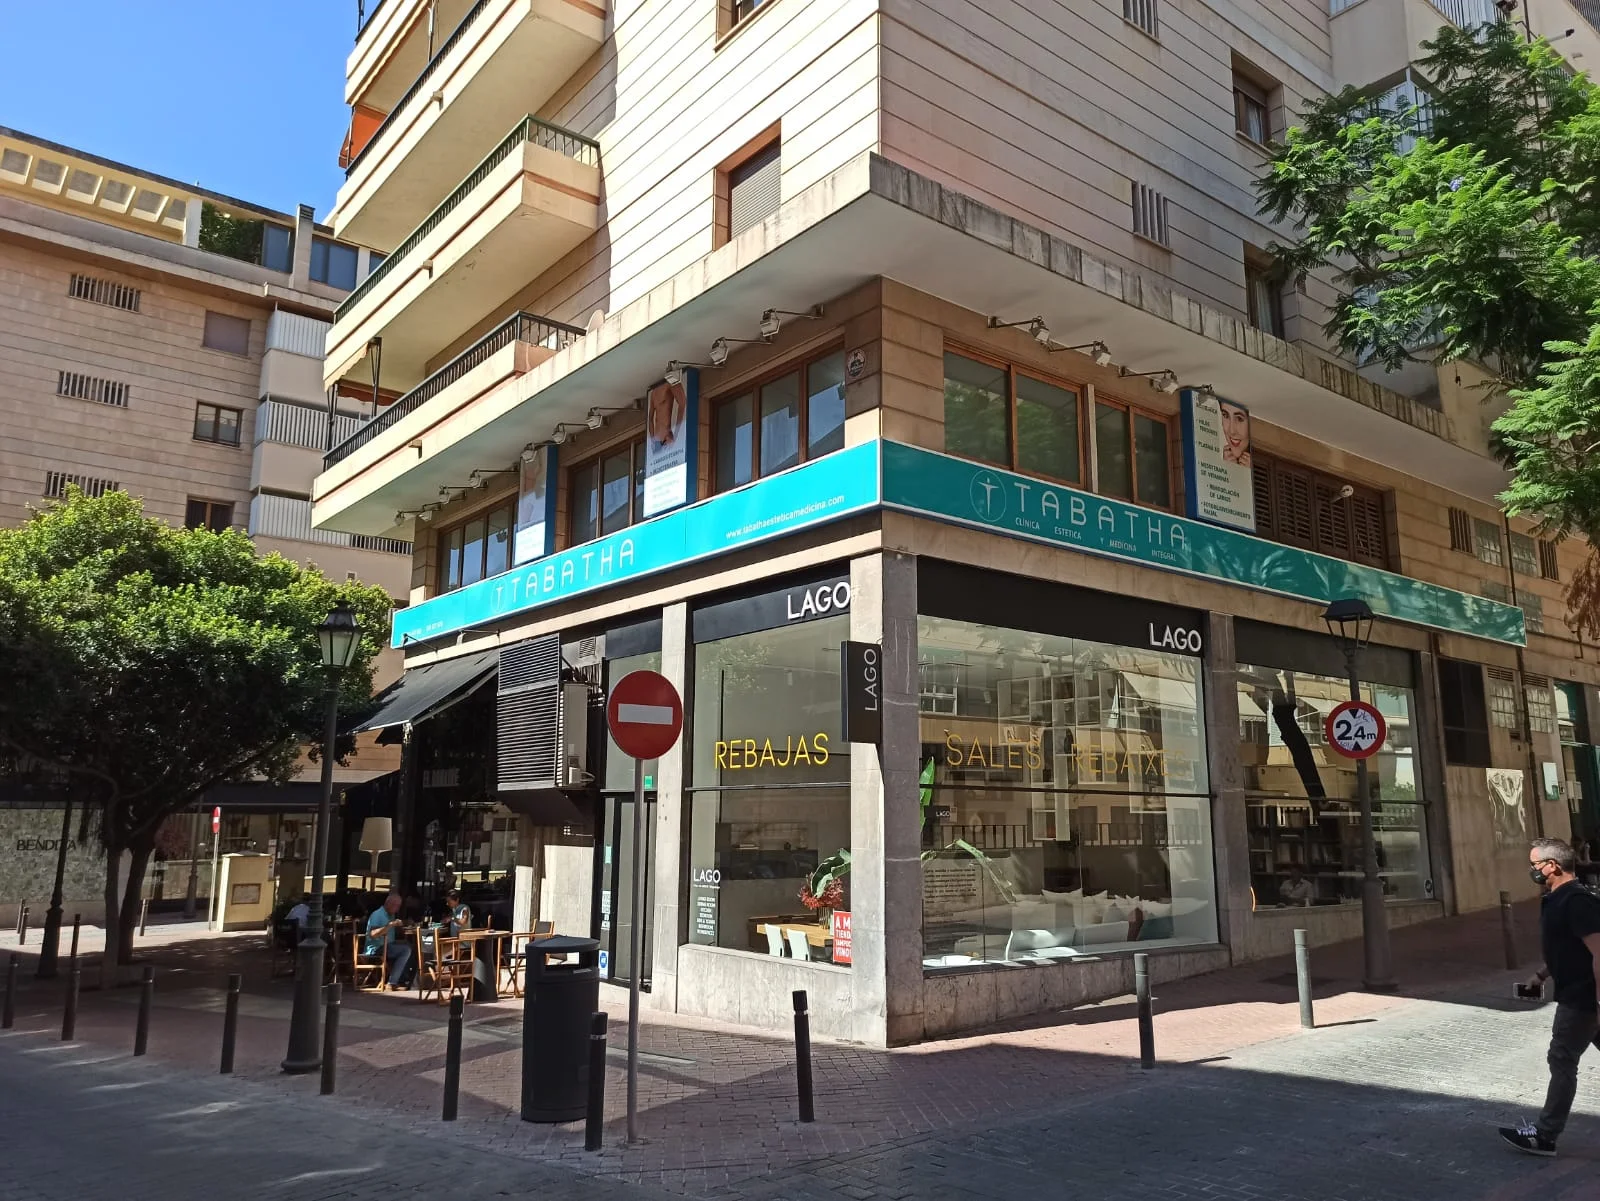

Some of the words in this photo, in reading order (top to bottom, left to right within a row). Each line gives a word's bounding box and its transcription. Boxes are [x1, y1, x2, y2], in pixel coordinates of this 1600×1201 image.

[725, 494, 845, 539] www.tabathaesteticamedicina.com
[1014, 482, 1186, 550] TABATHA
[511, 539, 634, 603] TABATHA
[1151, 549, 1177, 562] INTEGRAL
[787, 581, 851, 620] LAGO
[1149, 622, 1203, 653] LAGO
[864, 648, 878, 711] LAGO
[714, 732, 830, 770] REBAJAS
[945, 734, 1041, 770] SALES
[16, 838, 77, 851] BENDIA
[693, 868, 721, 884] LAGO
[835, 915, 842, 929] A
